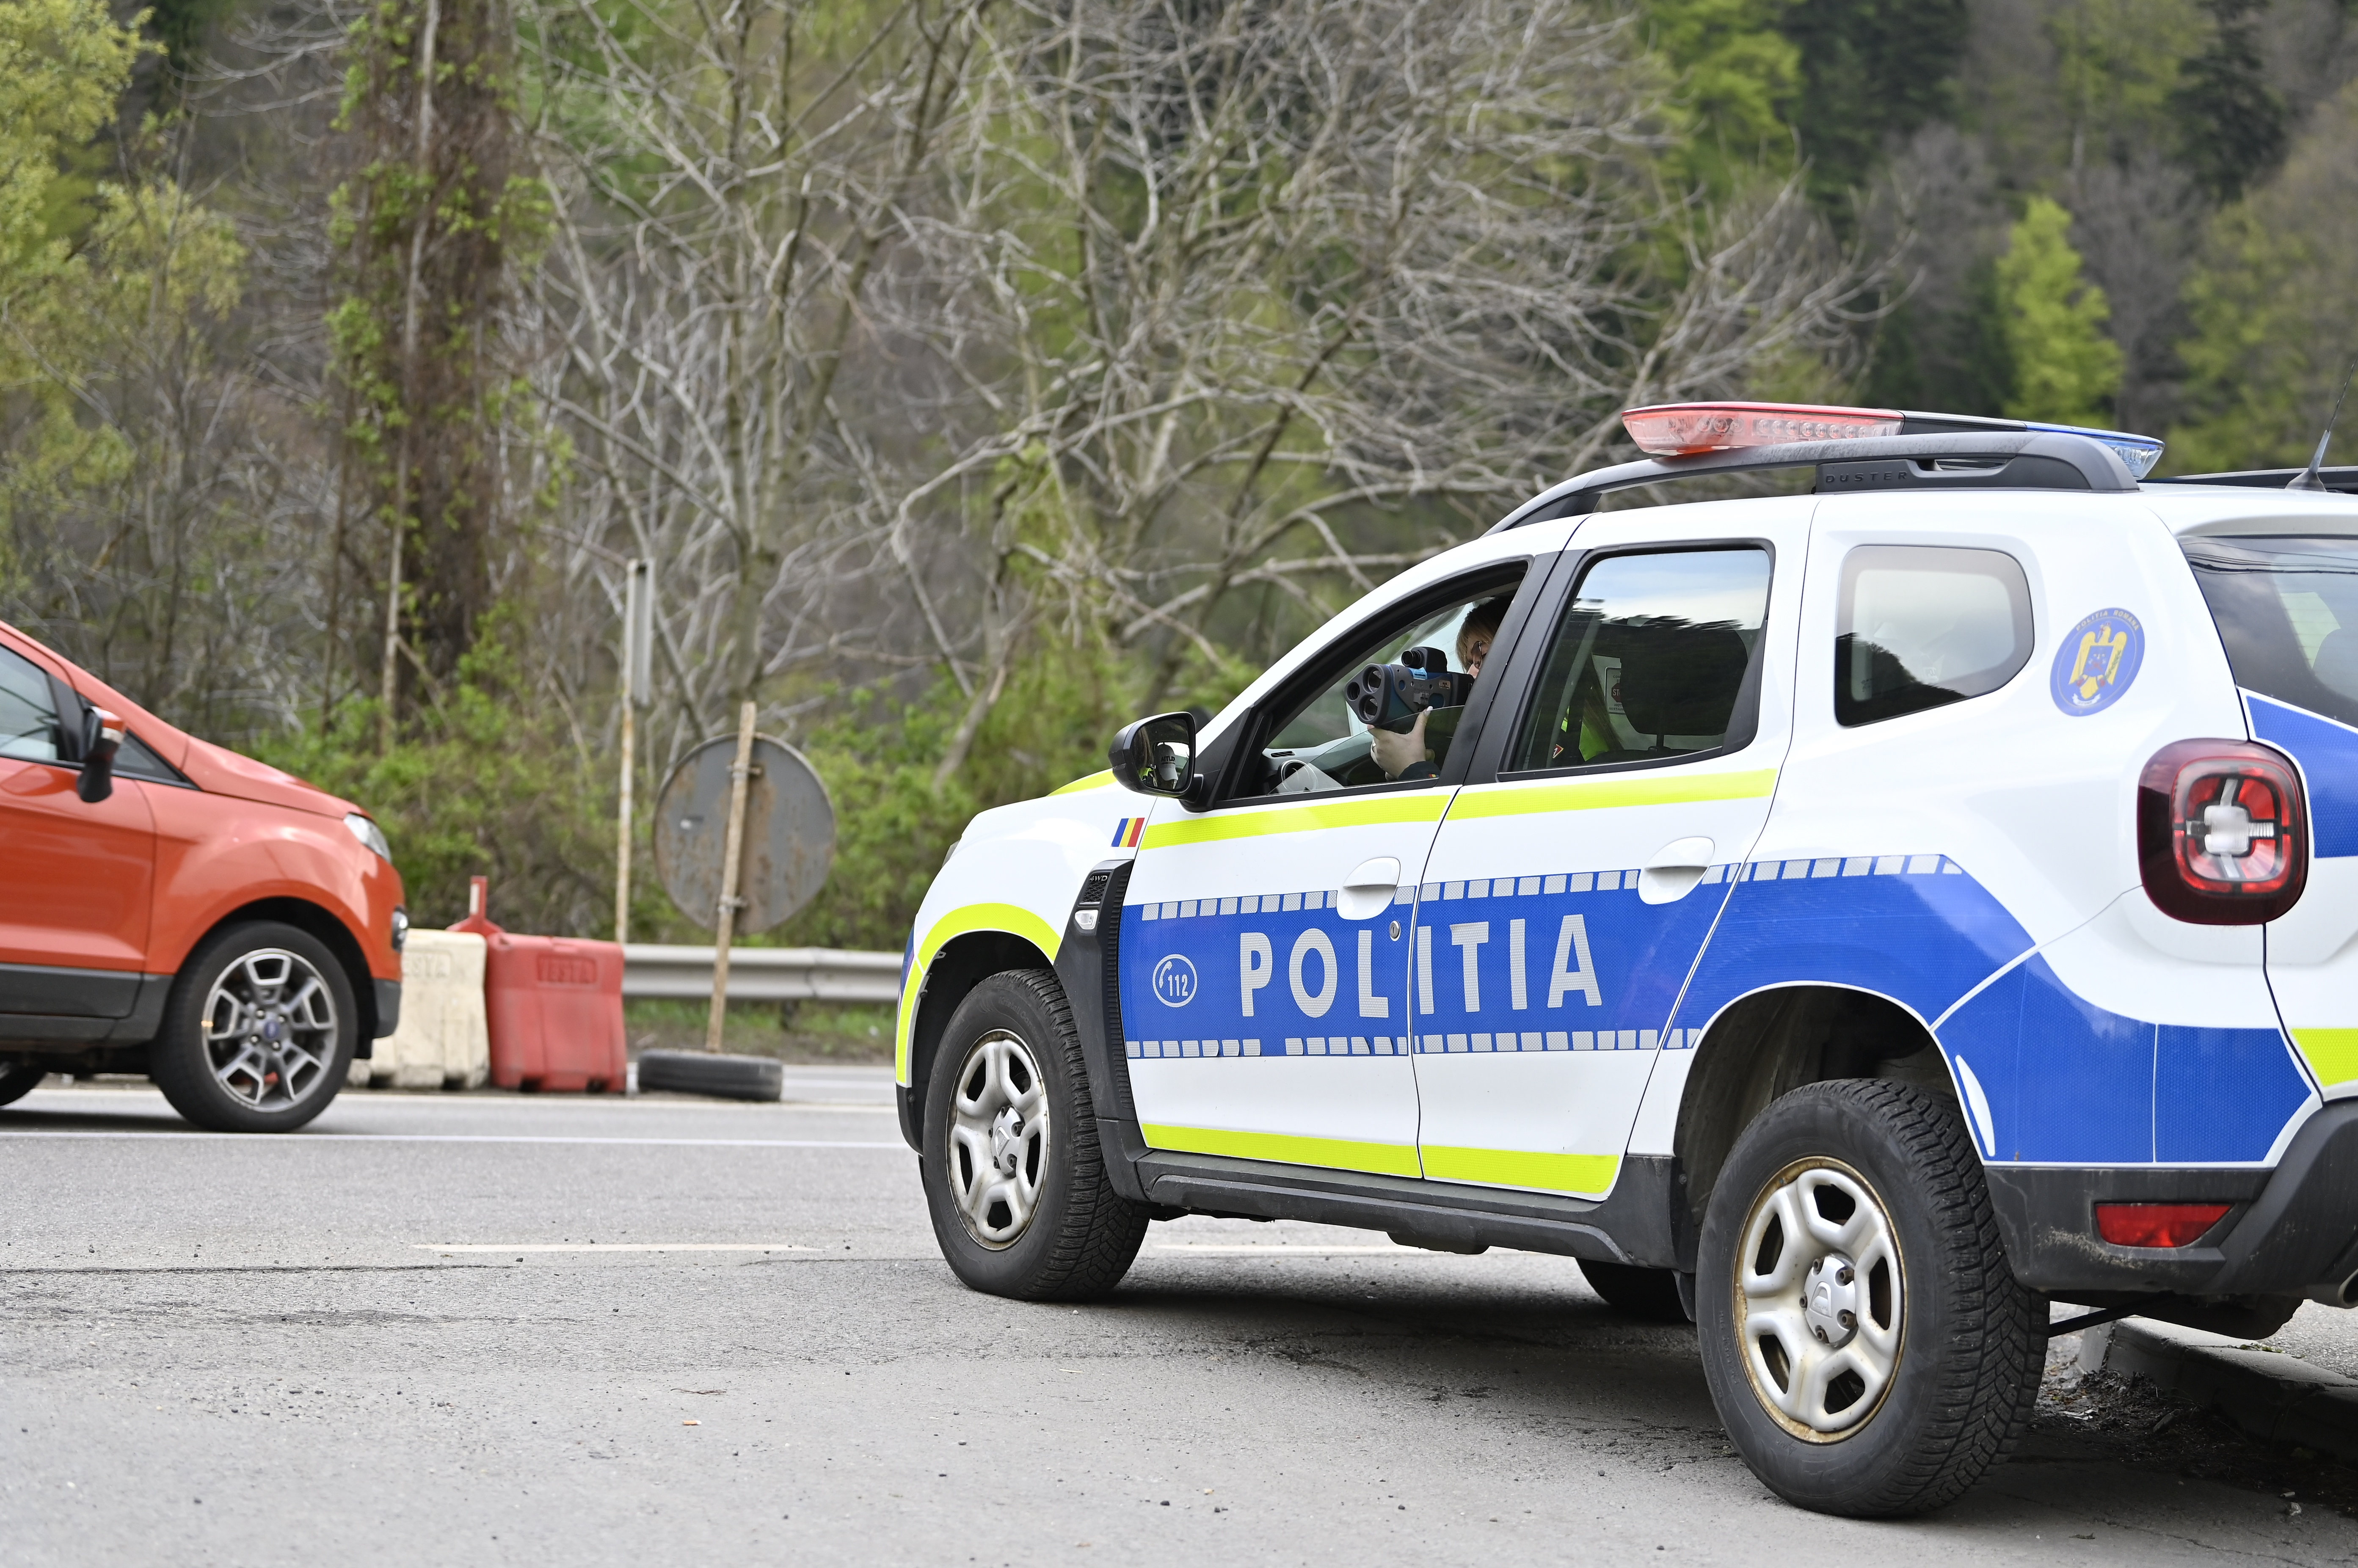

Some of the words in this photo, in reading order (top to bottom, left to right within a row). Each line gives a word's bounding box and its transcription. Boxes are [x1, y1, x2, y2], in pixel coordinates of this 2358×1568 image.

[1826, 471, 1908, 483] DUSTER
[402, 953, 448, 978] ESTA
[1240, 914, 1602, 1018] POLITIA
[1168, 974, 1188, 996] 112
